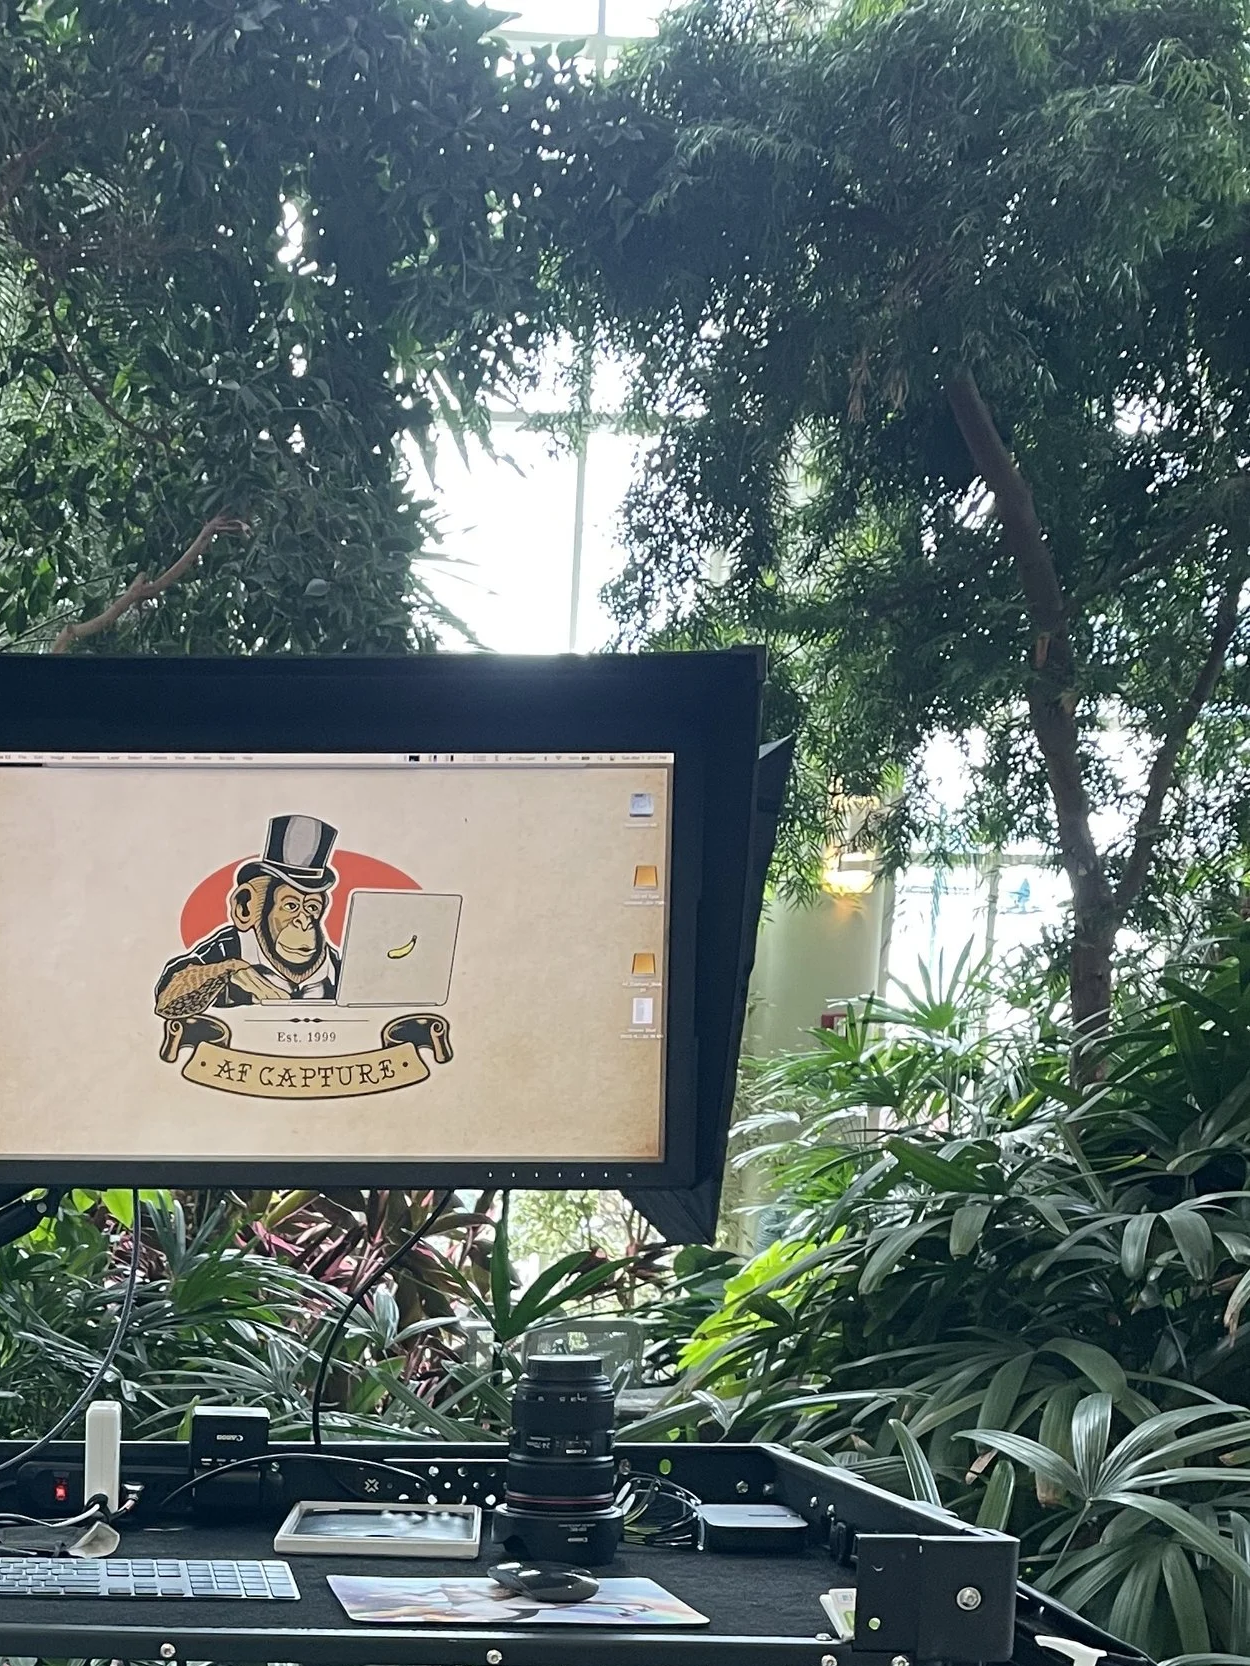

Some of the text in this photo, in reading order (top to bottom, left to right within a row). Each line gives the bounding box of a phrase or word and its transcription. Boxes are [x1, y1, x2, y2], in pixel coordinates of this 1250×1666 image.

[277, 1032, 336, 1043] Est. 1999
[214, 1059, 395, 1088] AF CAPTURE
[216, 1434, 244, 1442] Canon
